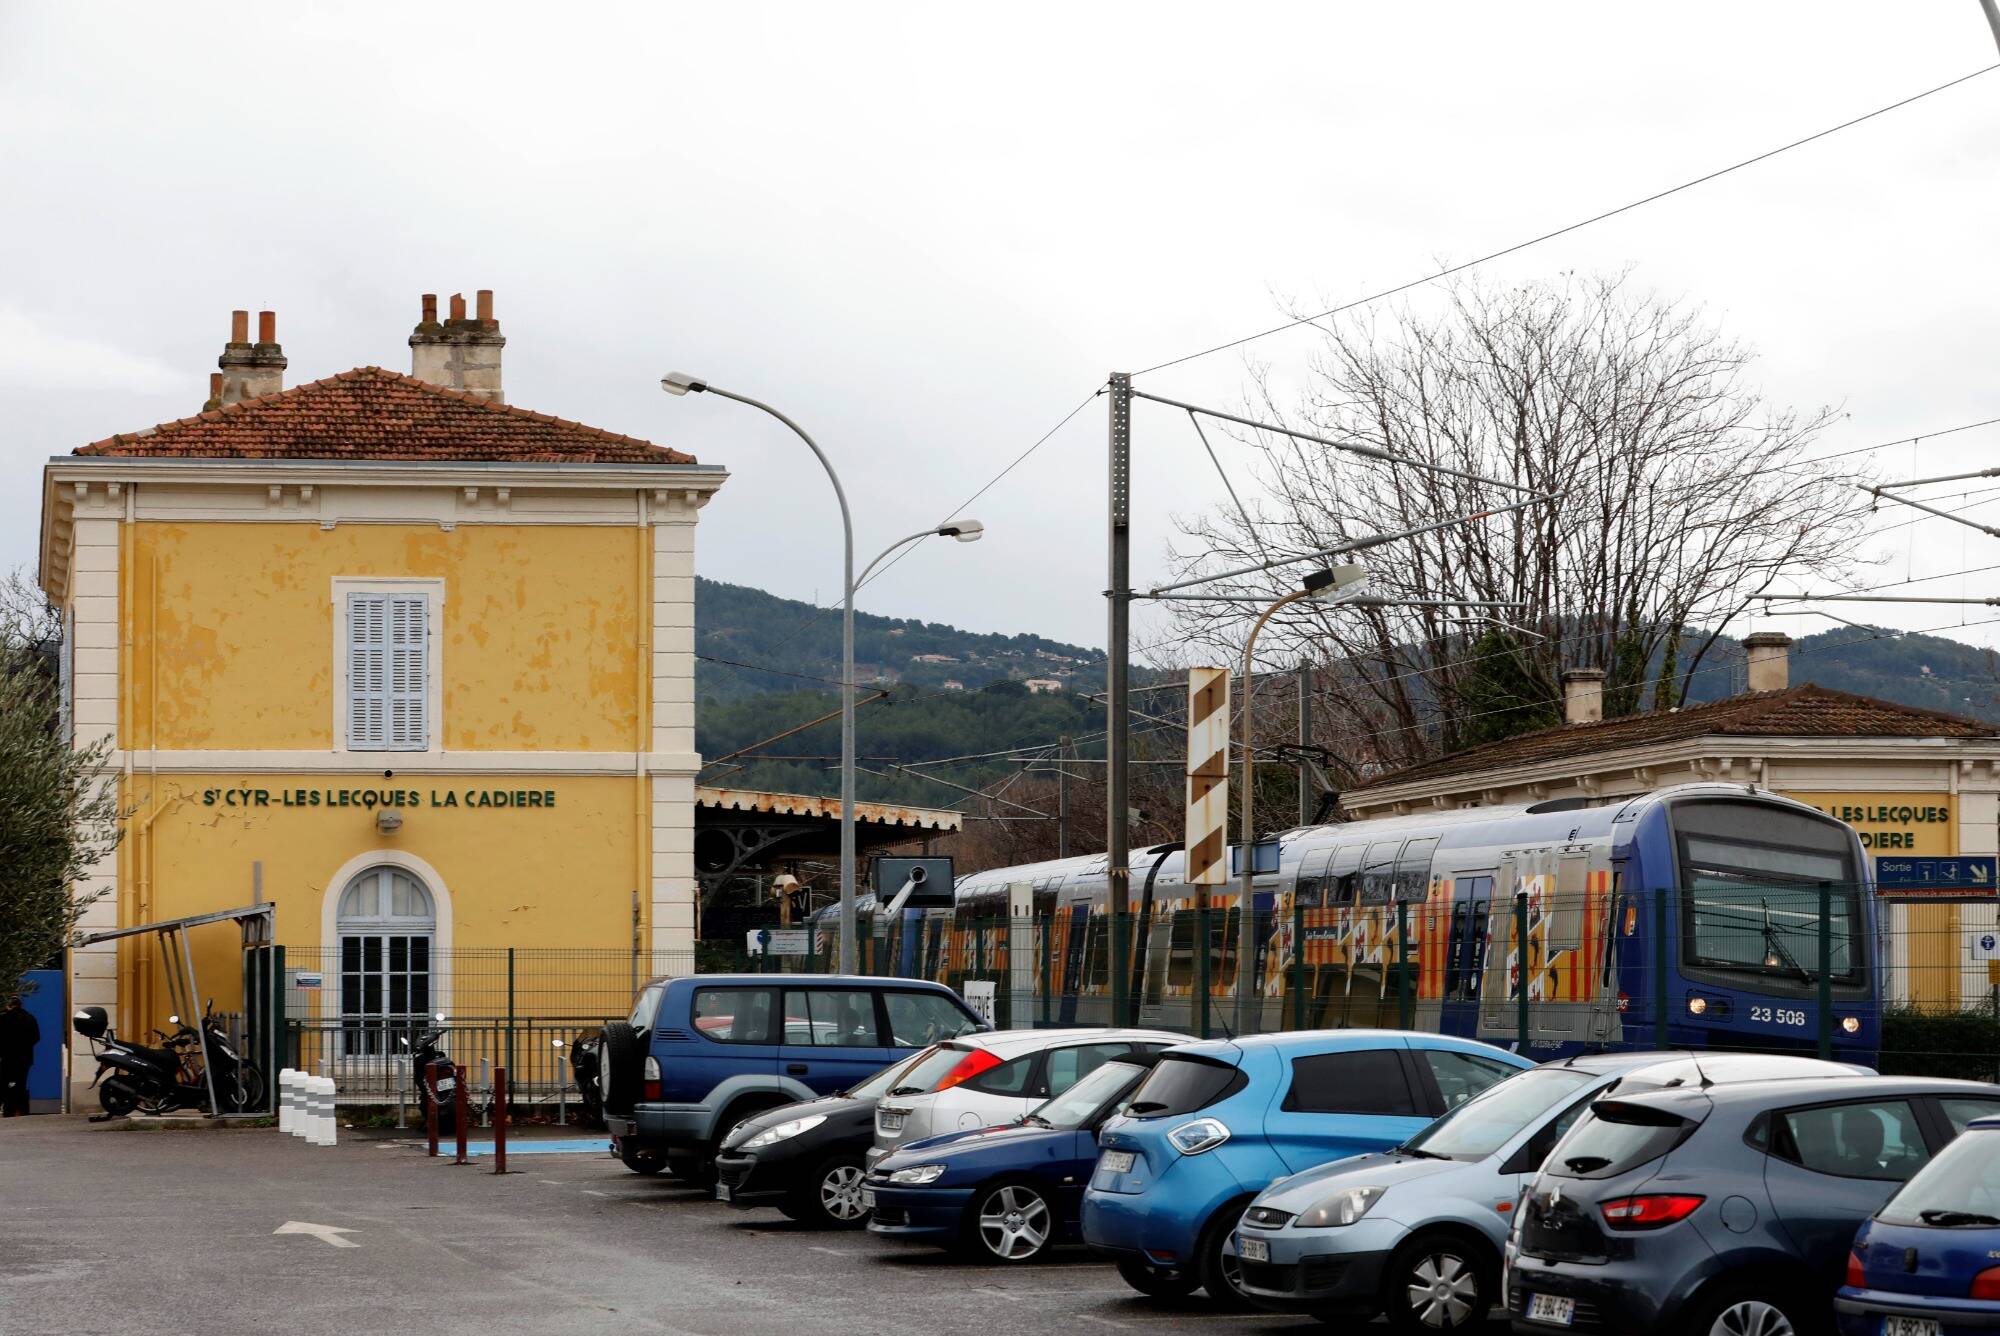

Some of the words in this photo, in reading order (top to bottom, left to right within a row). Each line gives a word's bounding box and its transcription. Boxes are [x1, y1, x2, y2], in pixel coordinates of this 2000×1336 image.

[326, 789, 421, 810] LECQUES
[431, 790, 458, 808] LA
[464, 790, 556, 808] CADIERE
[1867, 806, 1949, 826] LECQUES
[1858, 832, 1914, 849] DIERE
[1881, 861, 1912, 872] Sortie
[1923, 870, 1930, 880] 1
[1750, 1005, 1772, 1022] 23
[1775, 1008, 1806, 1026] 508
